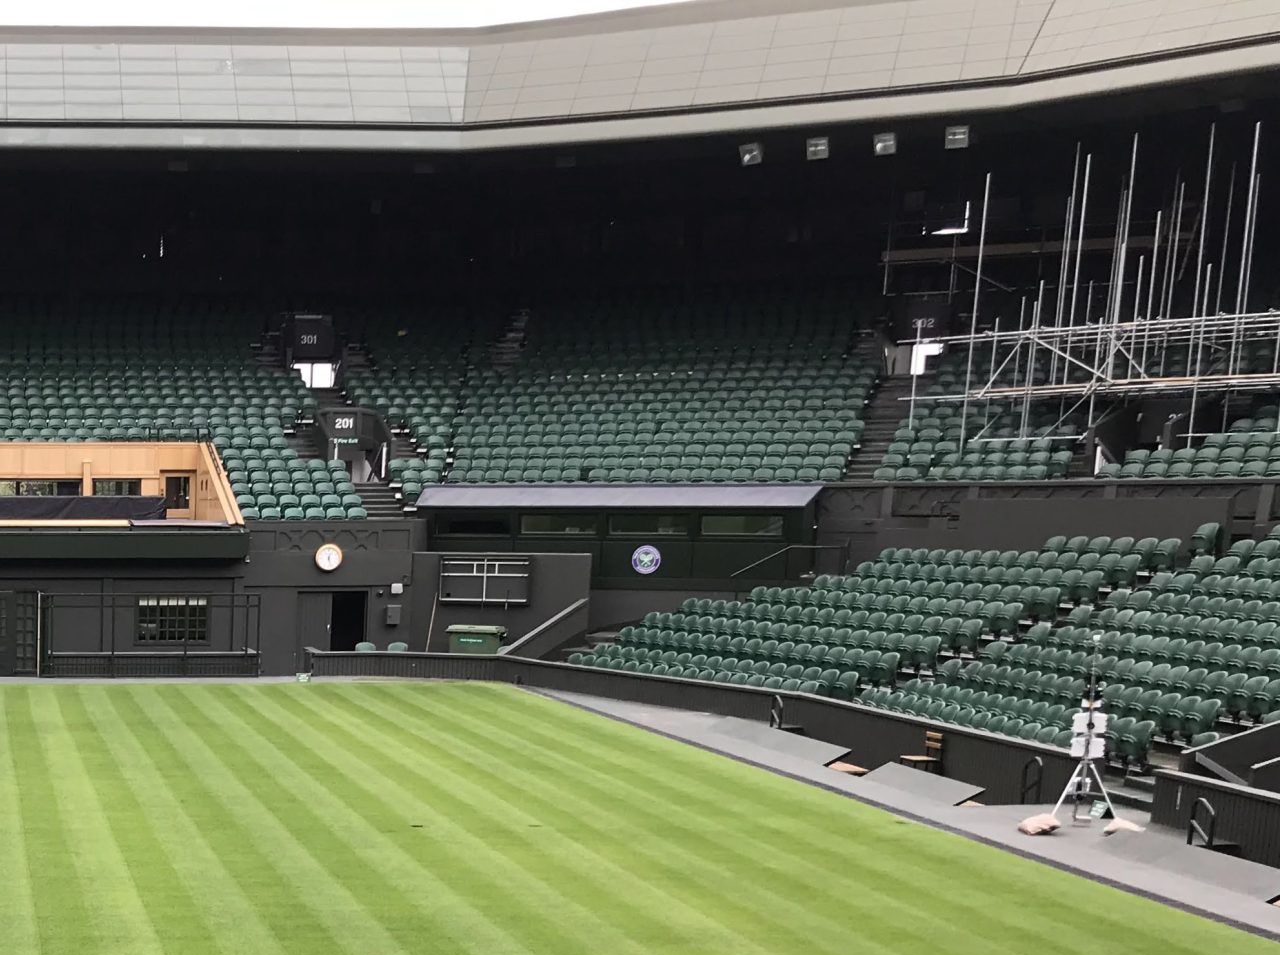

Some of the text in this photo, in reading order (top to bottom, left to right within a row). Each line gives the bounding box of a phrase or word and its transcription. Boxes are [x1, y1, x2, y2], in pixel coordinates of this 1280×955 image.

[912, 318, 935, 328] 302
[300, 335, 317, 345] 301
[334, 417, 354, 429] 201
